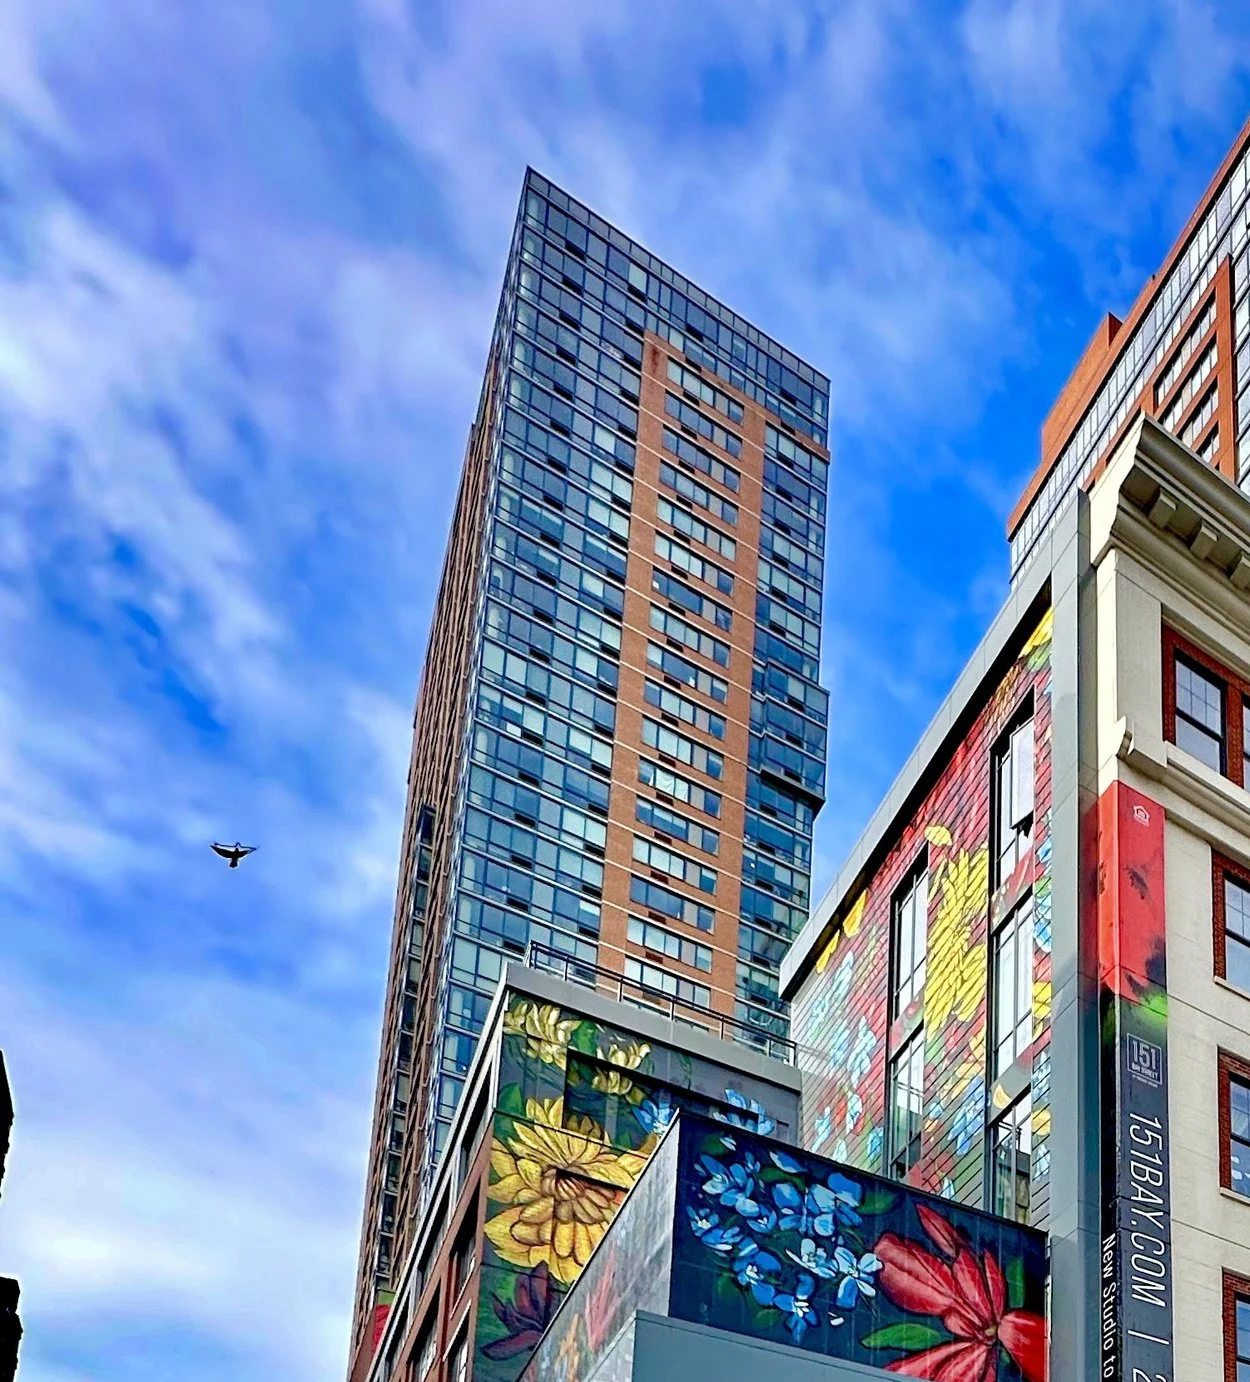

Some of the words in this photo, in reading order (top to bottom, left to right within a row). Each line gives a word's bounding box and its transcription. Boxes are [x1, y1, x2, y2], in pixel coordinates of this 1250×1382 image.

[1132, 1040, 1156, 1070] 151
[1129, 1112, 1167, 1308] 151BAY.COM
[1102, 1233, 1117, 1279] New
[1102, 1281, 1117, 1351] Studio
[1102, 1354, 1117, 1379] to
